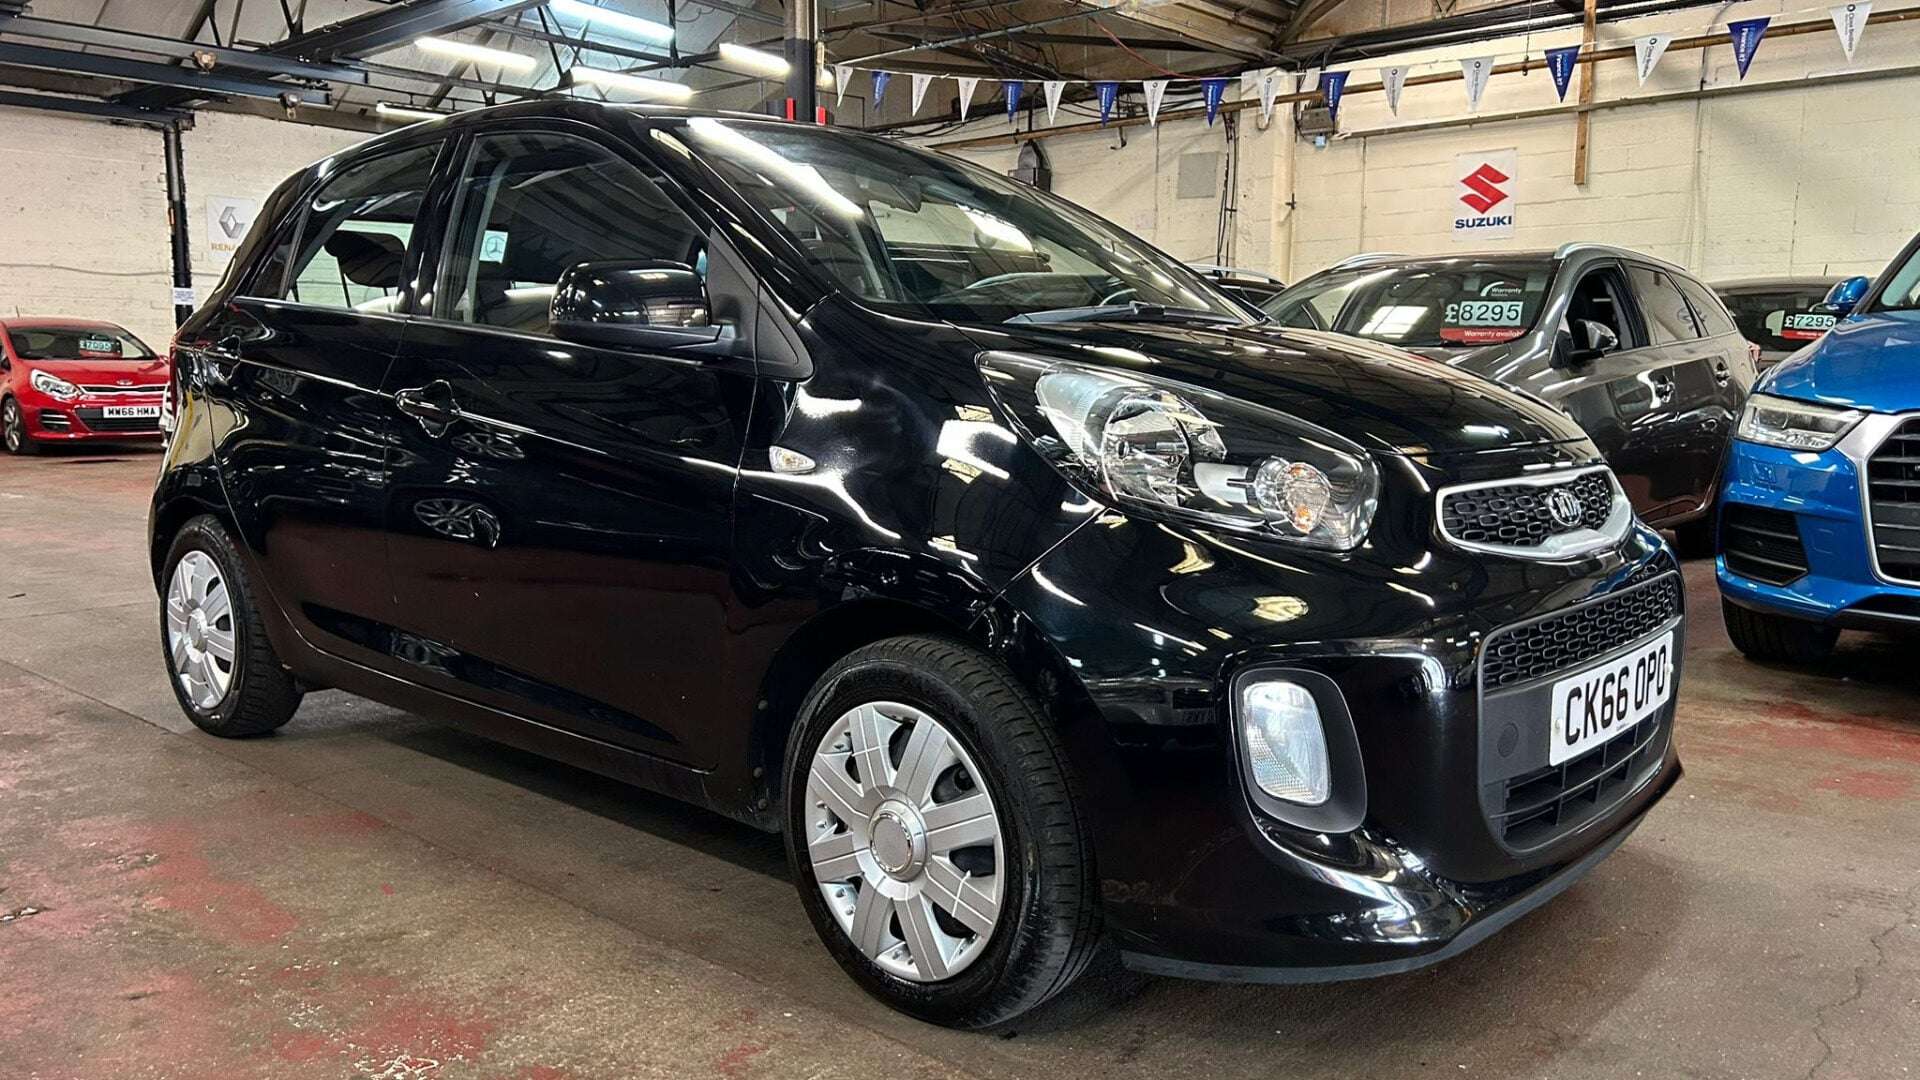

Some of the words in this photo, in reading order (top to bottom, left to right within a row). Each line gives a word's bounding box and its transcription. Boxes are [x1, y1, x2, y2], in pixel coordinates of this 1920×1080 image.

[1455, 215, 1512, 229] SUZUKI
[1444, 303, 1521, 323] £8295
[1784, 314, 1835, 328] £7295
[1464, 329, 1495, 338] Warranty
[136, 407, 156, 416] HMA
[1565, 665, 1630, 746] CK66
[1634, 644, 1667, 711] OPO
